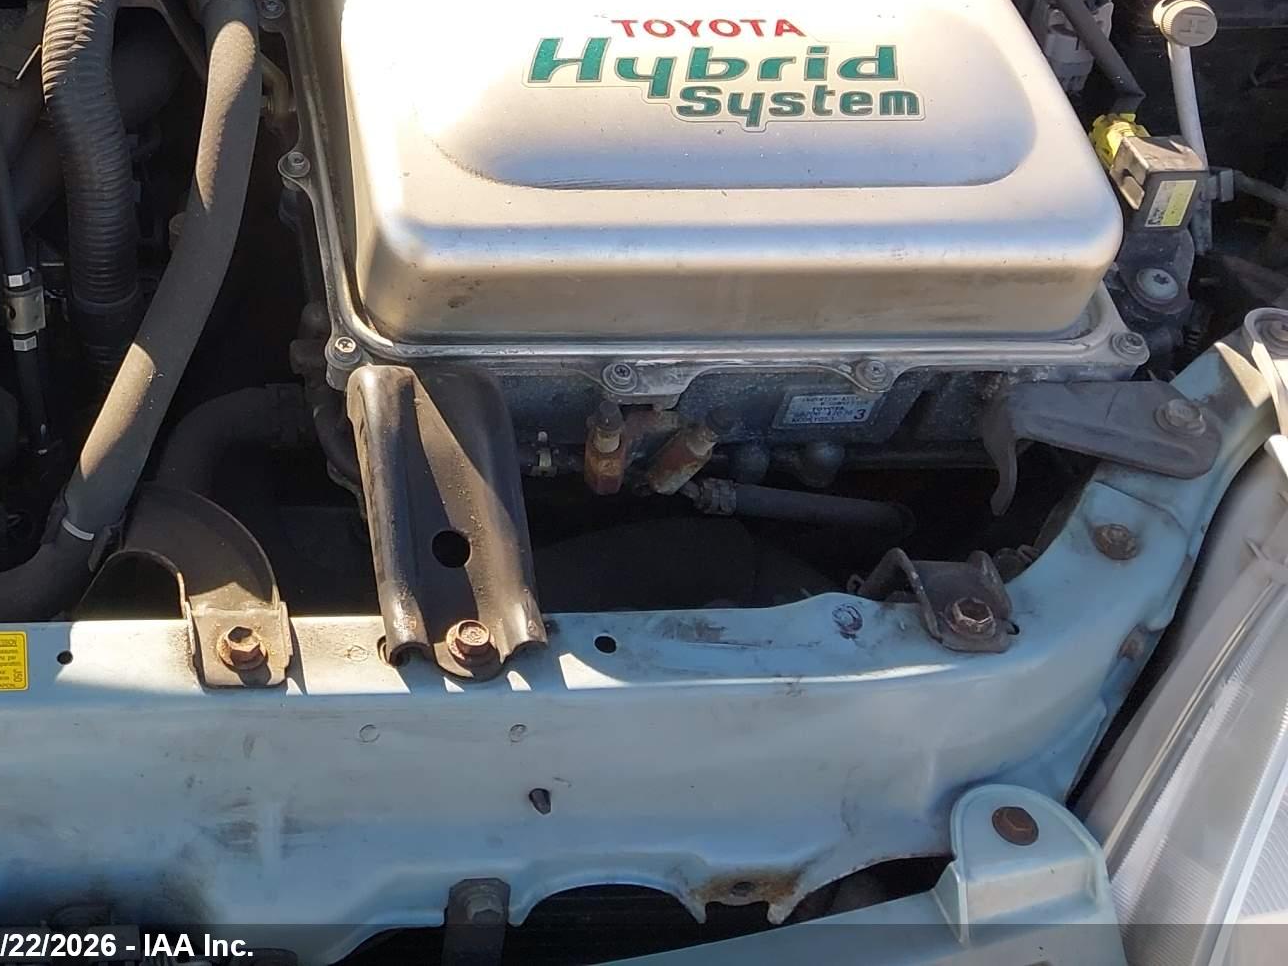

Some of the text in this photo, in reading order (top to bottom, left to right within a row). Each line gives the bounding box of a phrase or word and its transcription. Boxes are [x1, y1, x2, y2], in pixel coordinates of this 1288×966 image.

[612, 18, 807, 38] TOYOTA
[527, 37, 897, 99] Hybrid
[676, 85, 921, 128] System
[853, 408, 867, 420] 3
